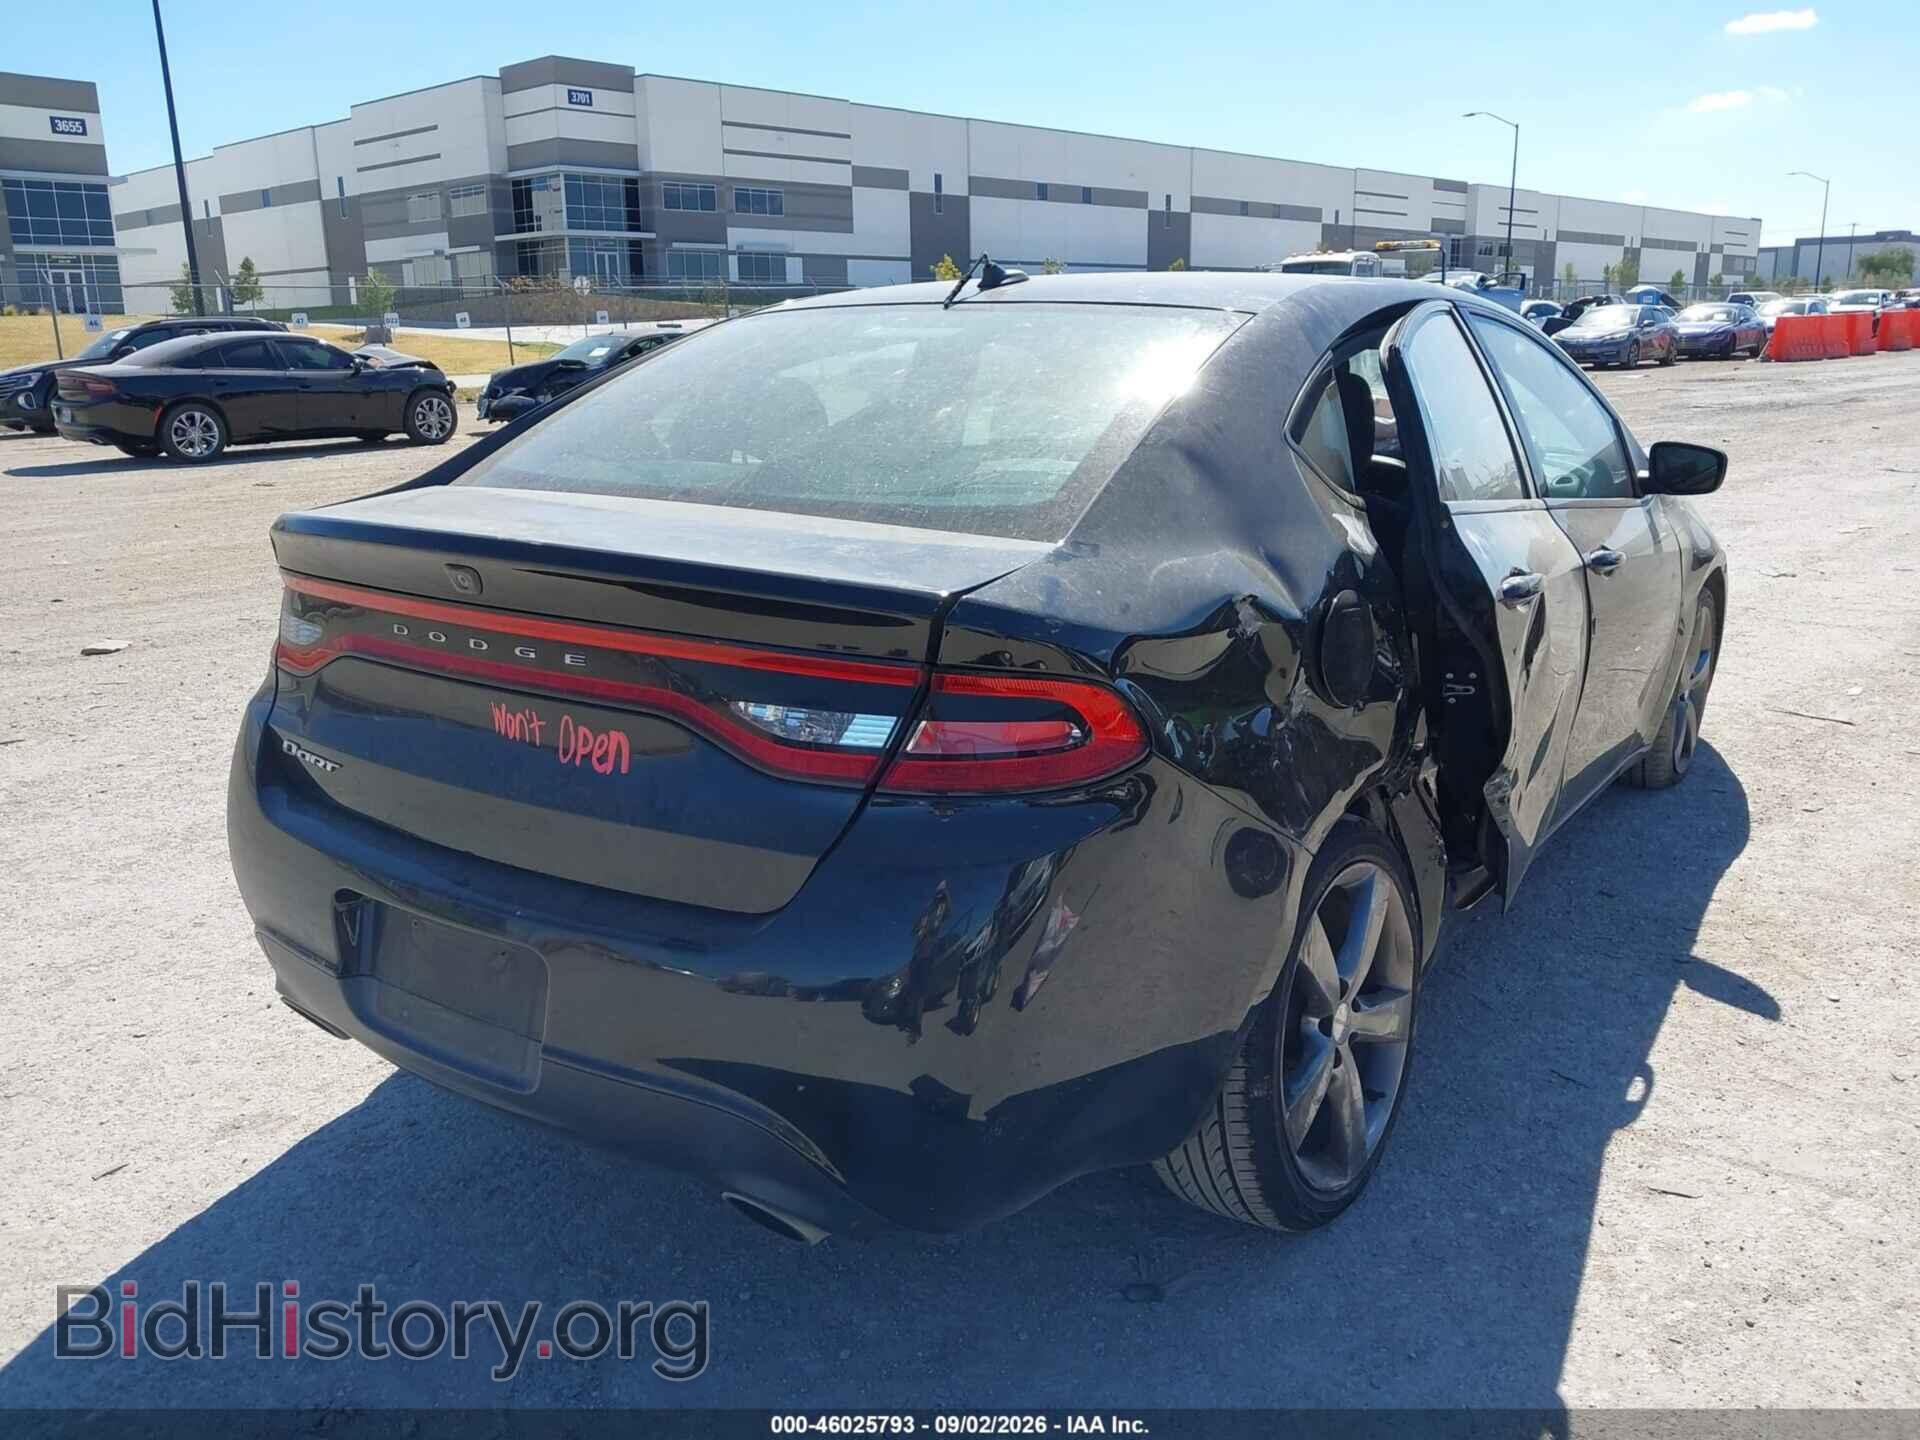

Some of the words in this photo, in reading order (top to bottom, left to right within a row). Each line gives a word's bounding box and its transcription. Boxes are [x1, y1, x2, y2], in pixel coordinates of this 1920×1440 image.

[54, 119, 83, 133] 3655
[393, 624, 588, 666] DODGE
[489, 701, 547, 746] Won't
[559, 714, 630, 775] Open
